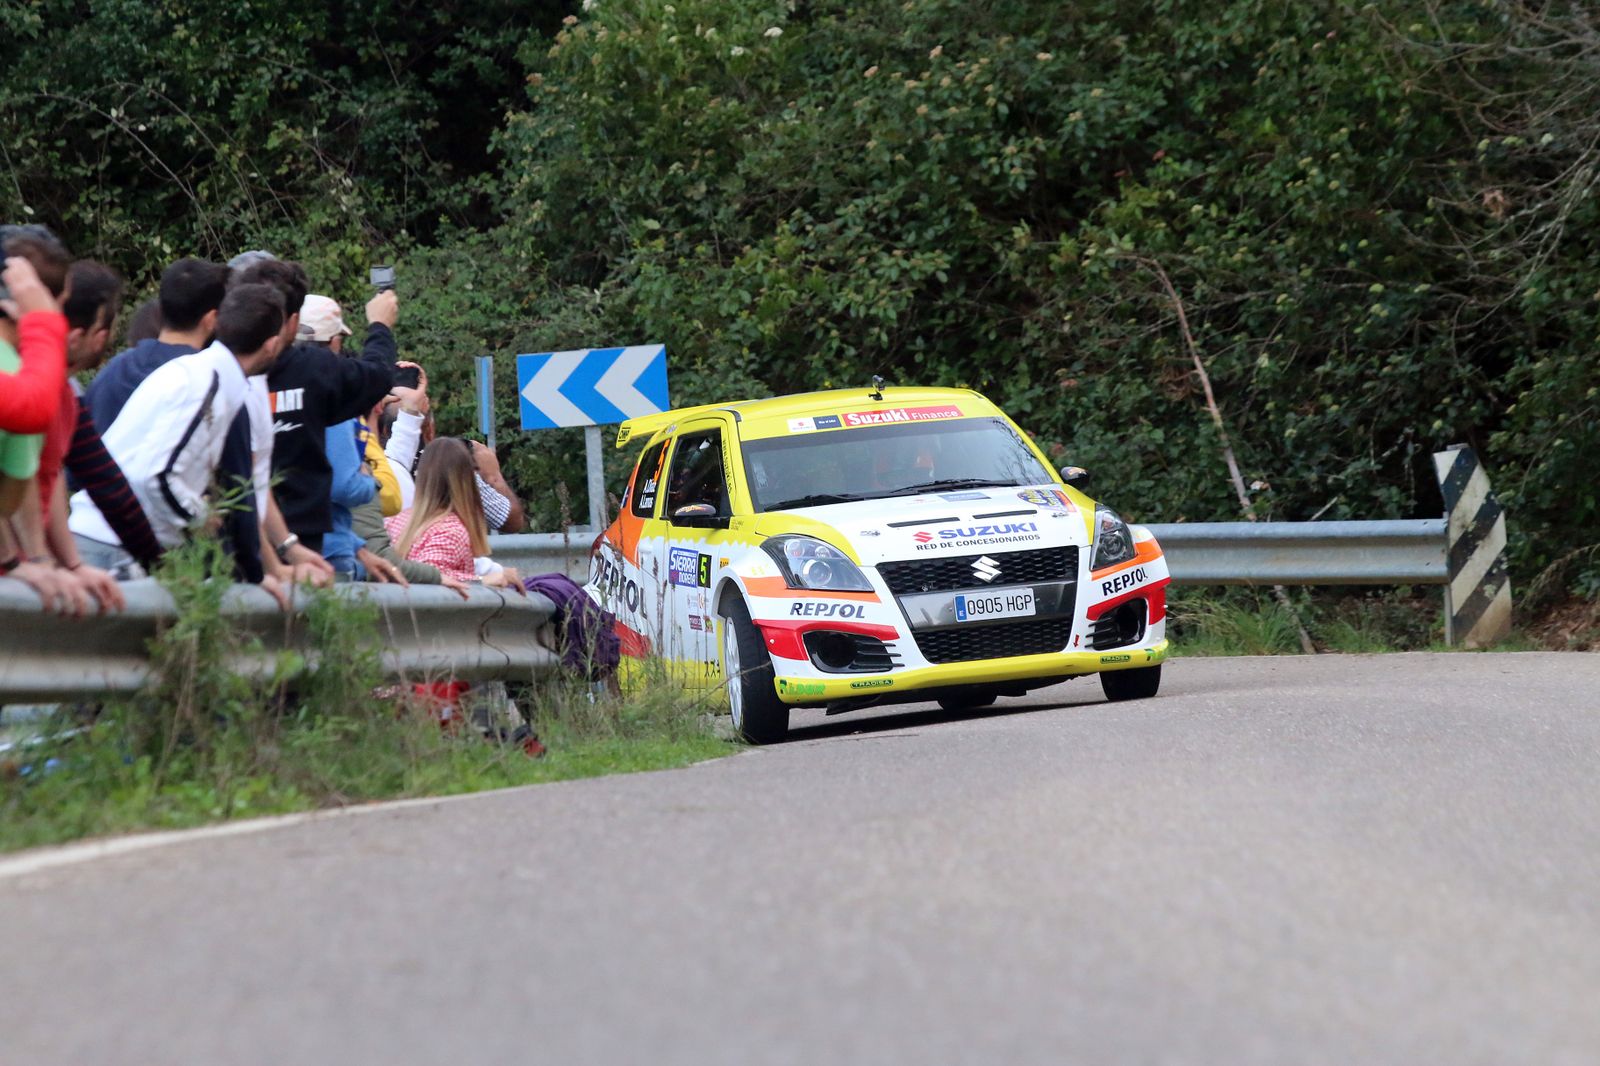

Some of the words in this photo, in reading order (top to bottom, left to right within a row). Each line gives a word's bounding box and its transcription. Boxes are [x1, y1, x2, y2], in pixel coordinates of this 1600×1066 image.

[847, 408, 910, 425] Suzuki
[911, 409, 958, 420] Finance
[937, 522, 1038, 539] SUZUKI
[916, 543, 938, 551] RED
[956, 534, 1041, 547] CONCESIONARIOS
[700, 556, 708, 584] 5
[1101, 567, 1148, 596] REPSOL
[789, 602, 865, 618] REPSOL
[967, 597, 1003, 615] 0905
[1006, 594, 1032, 611] HGP
